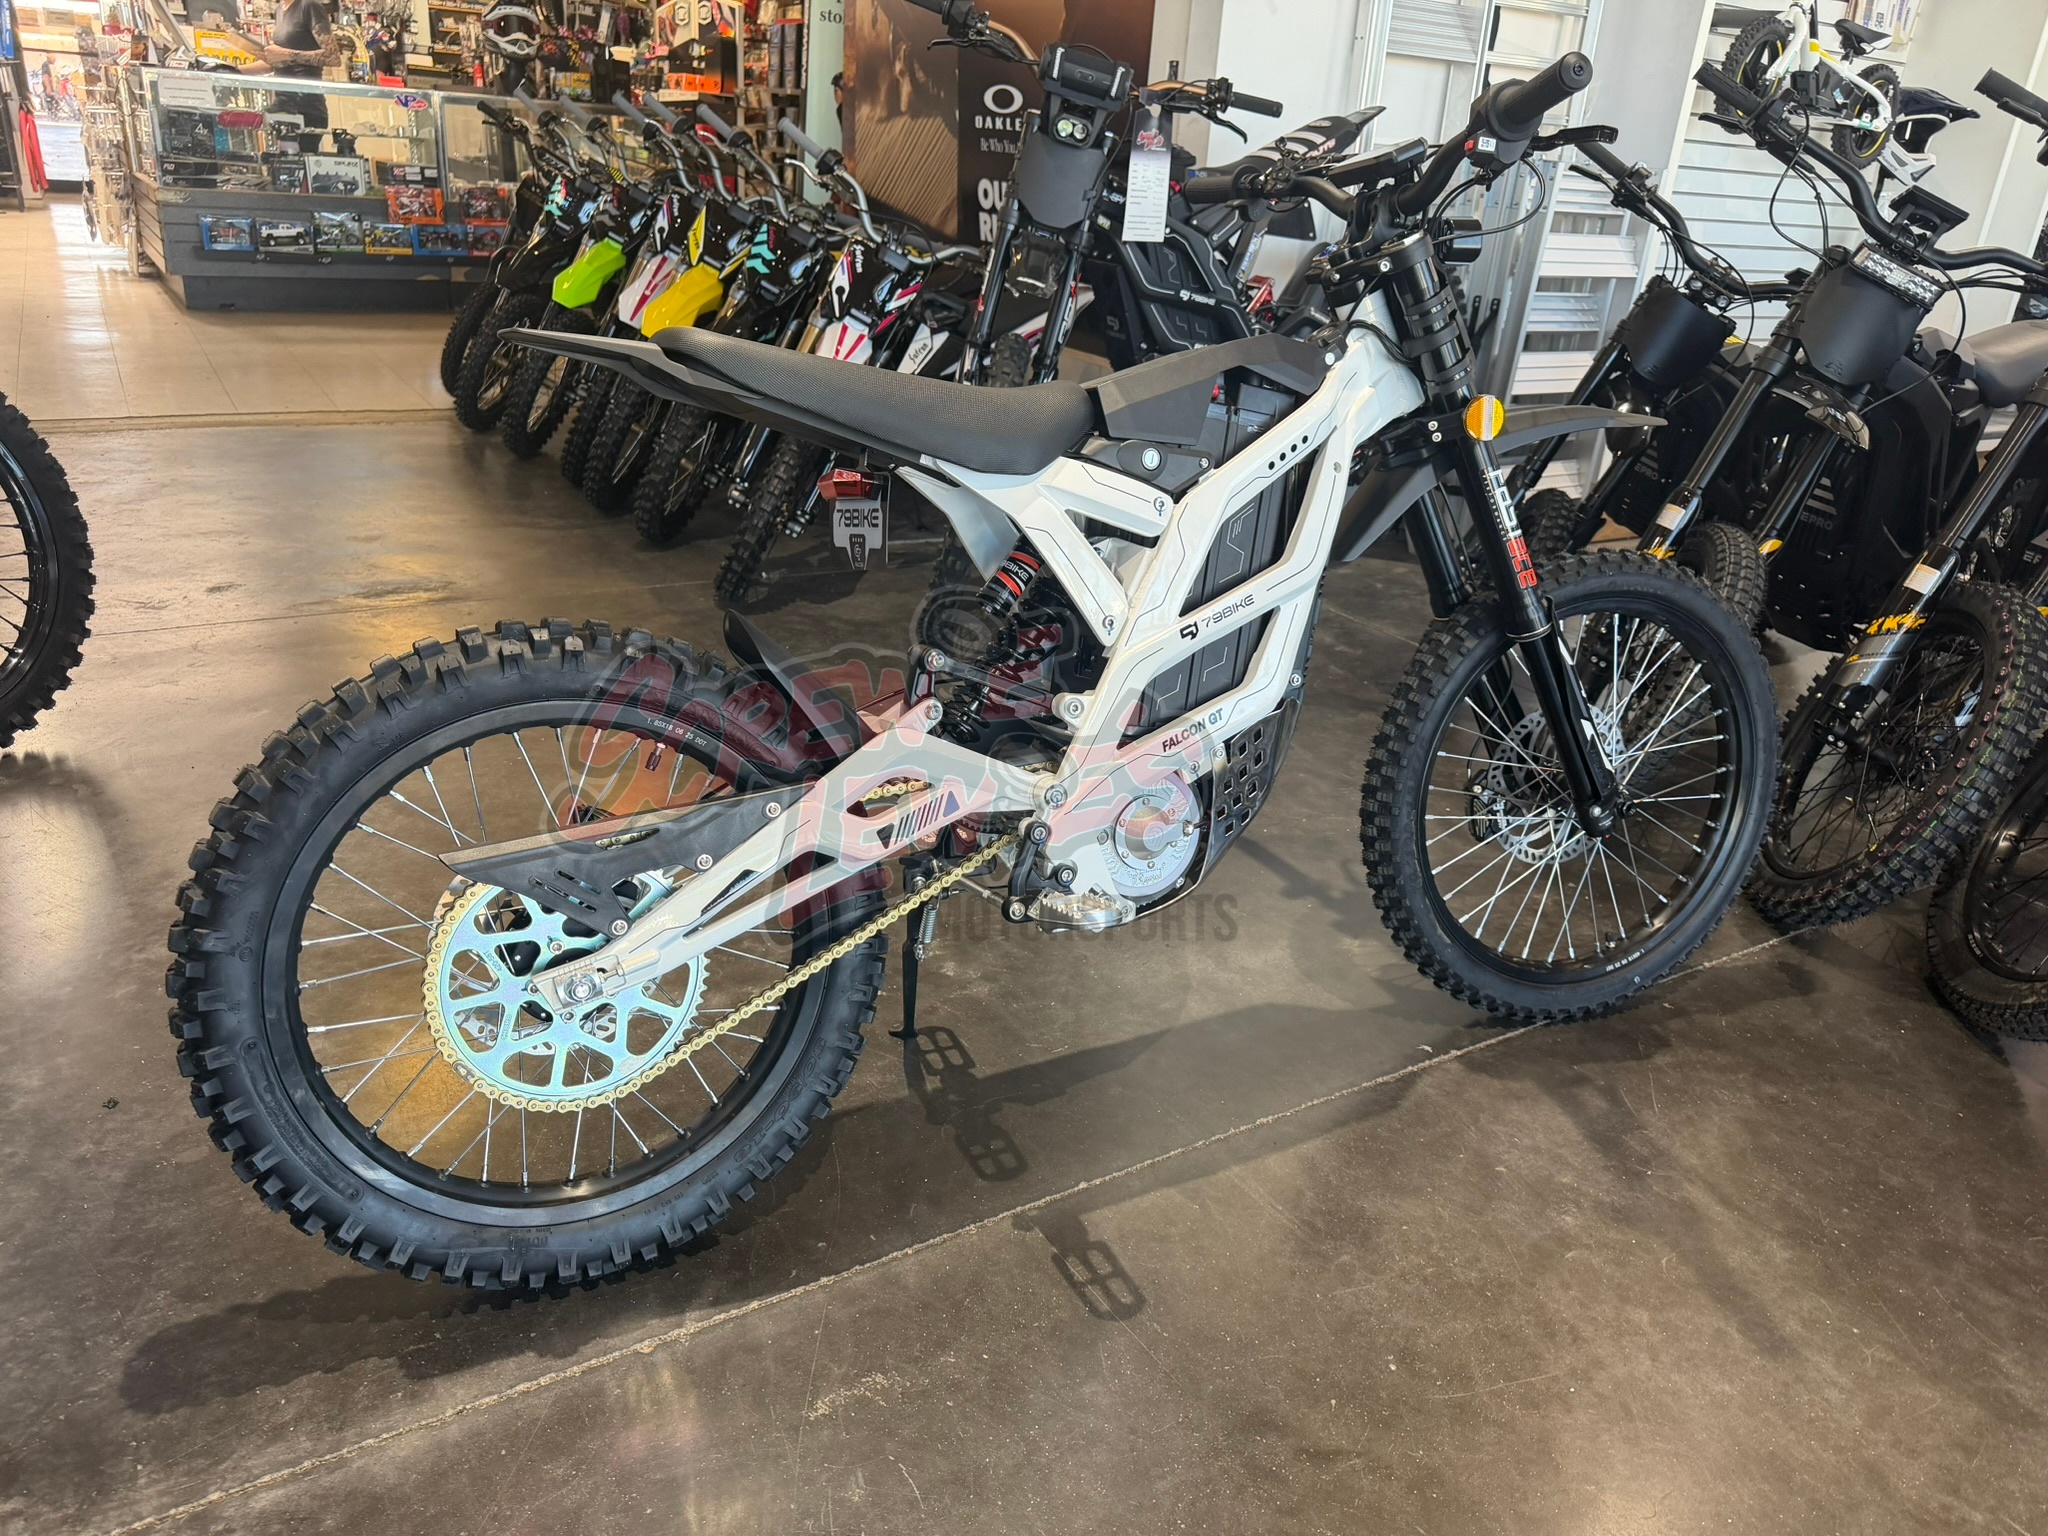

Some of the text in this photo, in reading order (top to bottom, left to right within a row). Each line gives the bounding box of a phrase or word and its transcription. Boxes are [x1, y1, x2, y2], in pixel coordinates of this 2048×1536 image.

[820, 9, 844, 24] sto
[974, 115, 1022, 131] OAKLE
[977, 177, 1008, 212] OU
[836, 508, 880, 528] 79BIKE
[1800, 511, 1833, 530] EPRO
[1202, 594, 1255, 628] 79BIKE
[1162, 708, 1224, 753] FALCON GT
